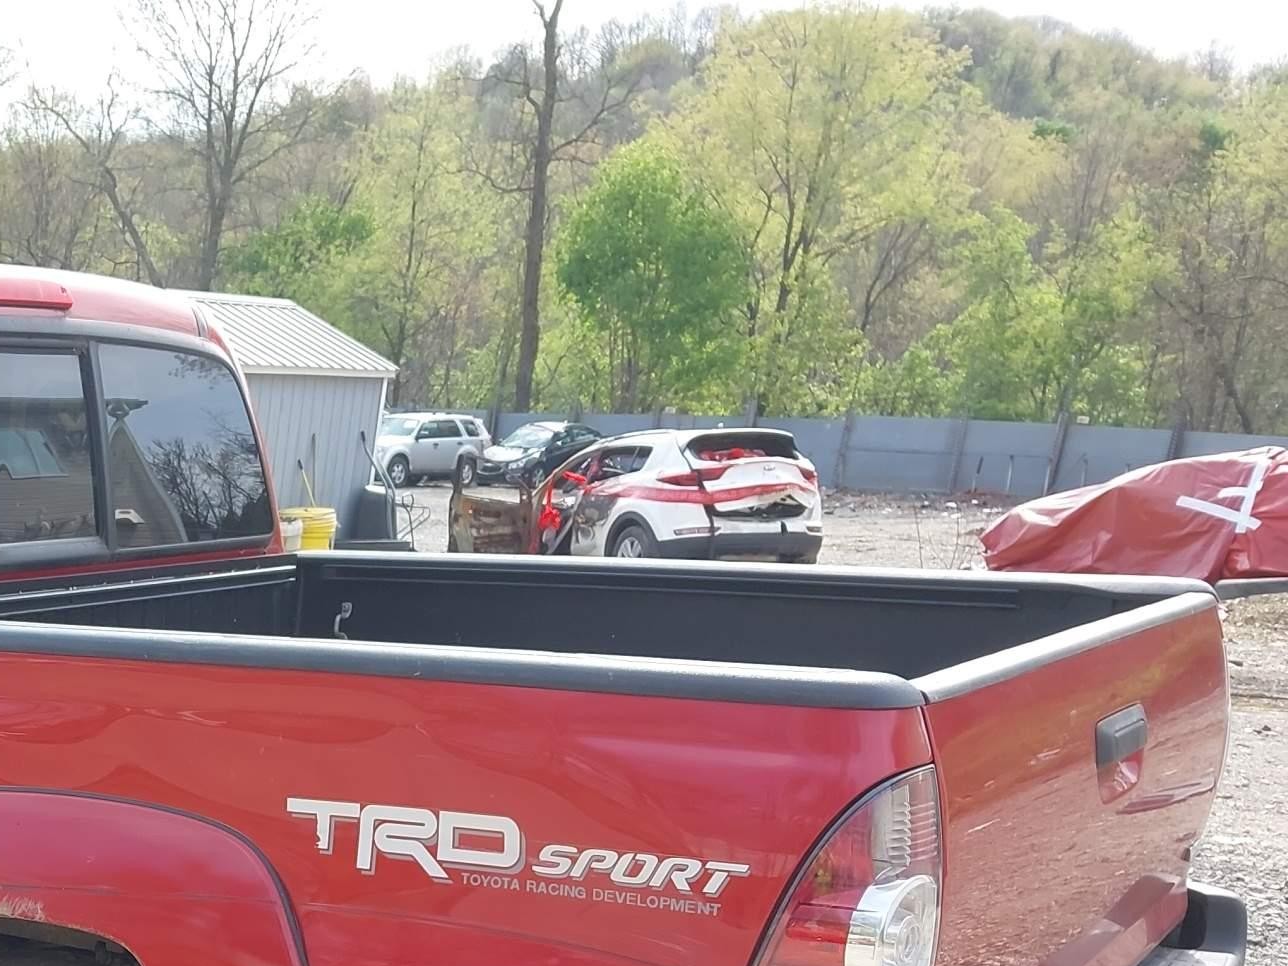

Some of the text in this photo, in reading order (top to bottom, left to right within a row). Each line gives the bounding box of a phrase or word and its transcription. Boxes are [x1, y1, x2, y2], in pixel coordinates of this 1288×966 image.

[286, 797, 751, 898] TRD SPORT
[461, 871, 722, 917] TOYOTA RACING DEVELOPMENT
